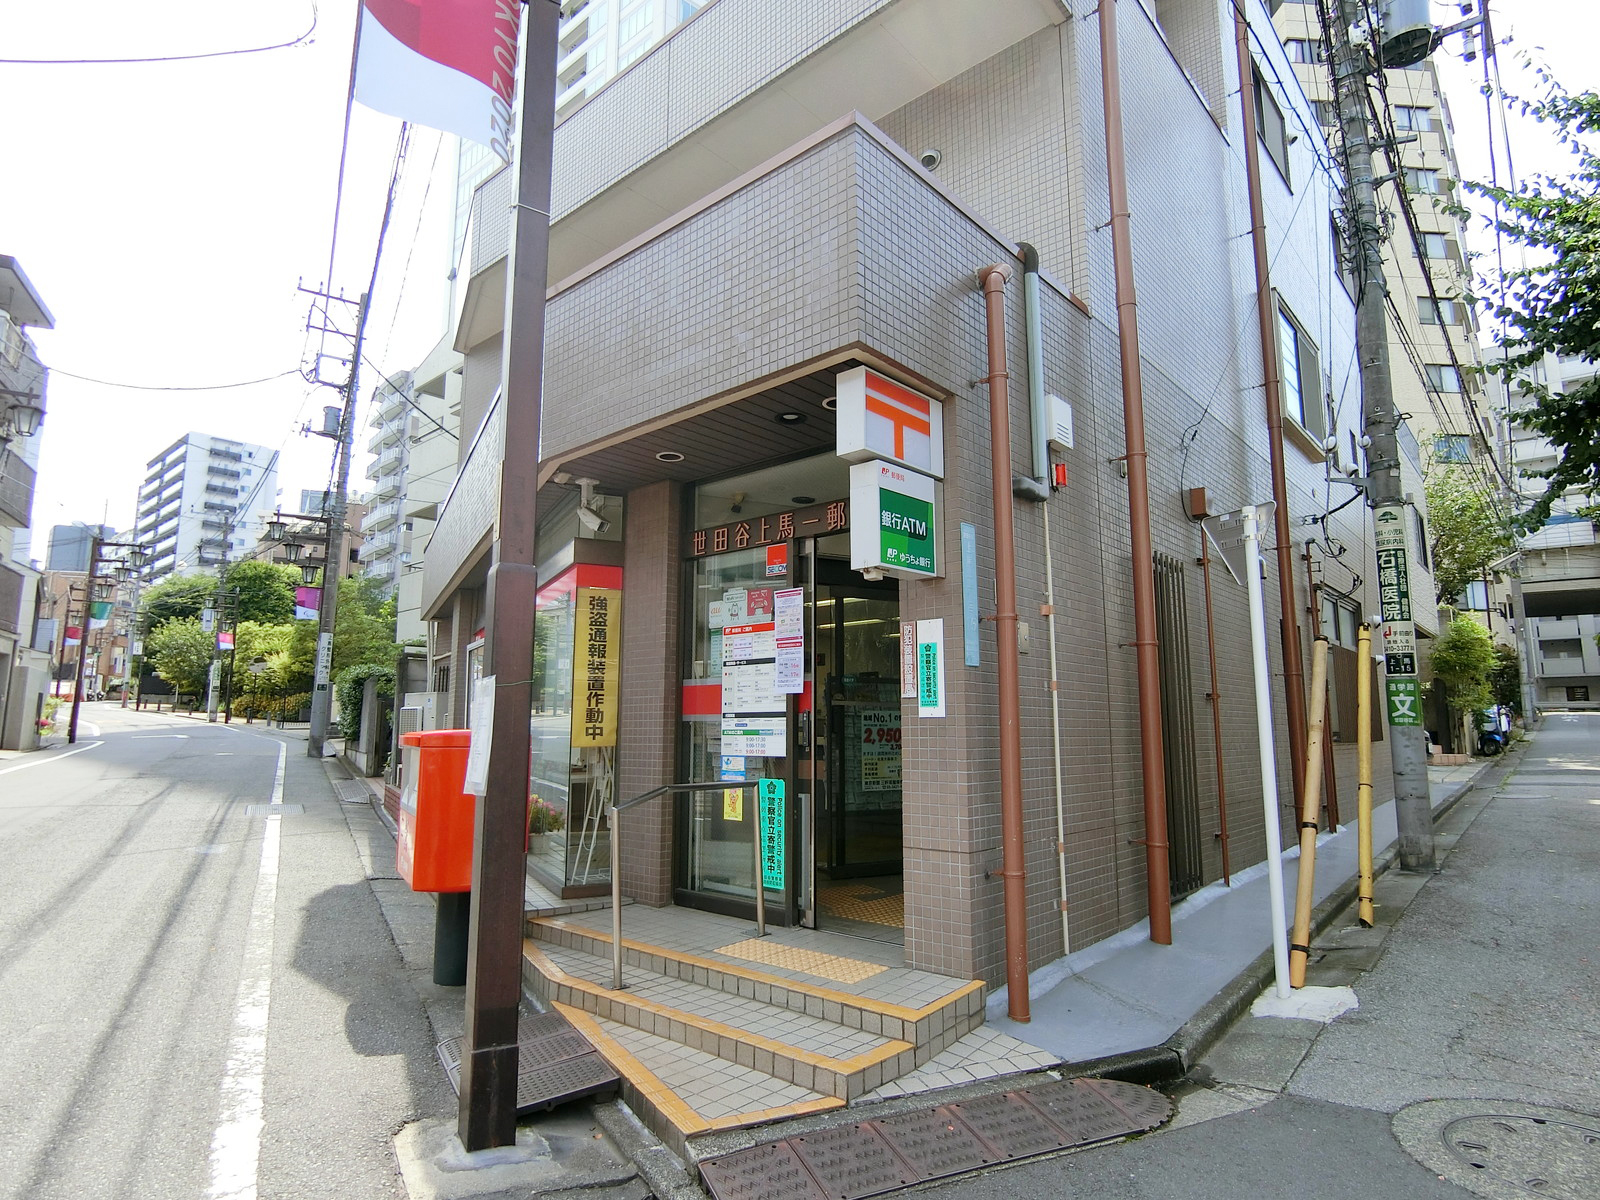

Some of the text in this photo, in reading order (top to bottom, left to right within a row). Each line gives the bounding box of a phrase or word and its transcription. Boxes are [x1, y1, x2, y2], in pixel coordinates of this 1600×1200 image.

[693, 502, 846, 556] 世田谷上馬一郵
[881, 510, 926, 537] 銀行ATM
[899, 552, 931, 568] ゆうちょ銀行
[1378, 550, 1401, 620] 石橋医院
[585, 595, 608, 741] 強盗通報装置作動中
[1389, 683, 1415, 691] 通学路
[1390, 693, 1416, 717] 文
[766, 796, 776, 874] 警察官立寄警戒中
[777, 818, 783, 828] on
